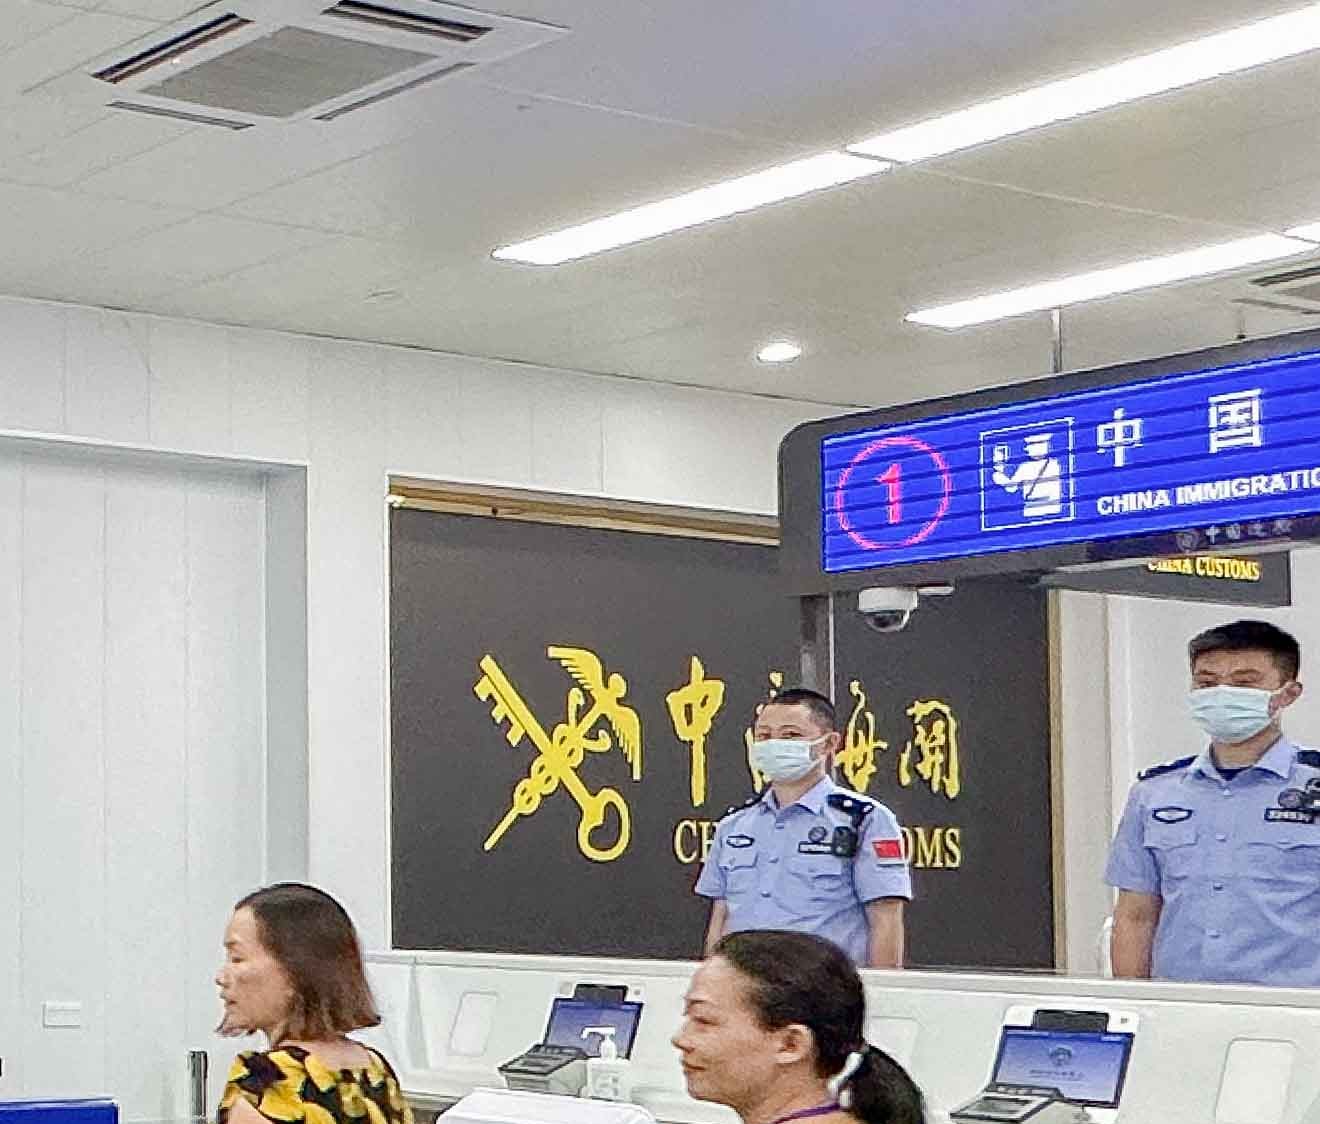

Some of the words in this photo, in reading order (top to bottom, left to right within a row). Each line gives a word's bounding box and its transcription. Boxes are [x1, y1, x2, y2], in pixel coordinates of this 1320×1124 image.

[874, 462, 903, 524] 1
[1096, 487, 1172, 515] CHINA
[1195, 556, 1260, 581] CUSTOMS
